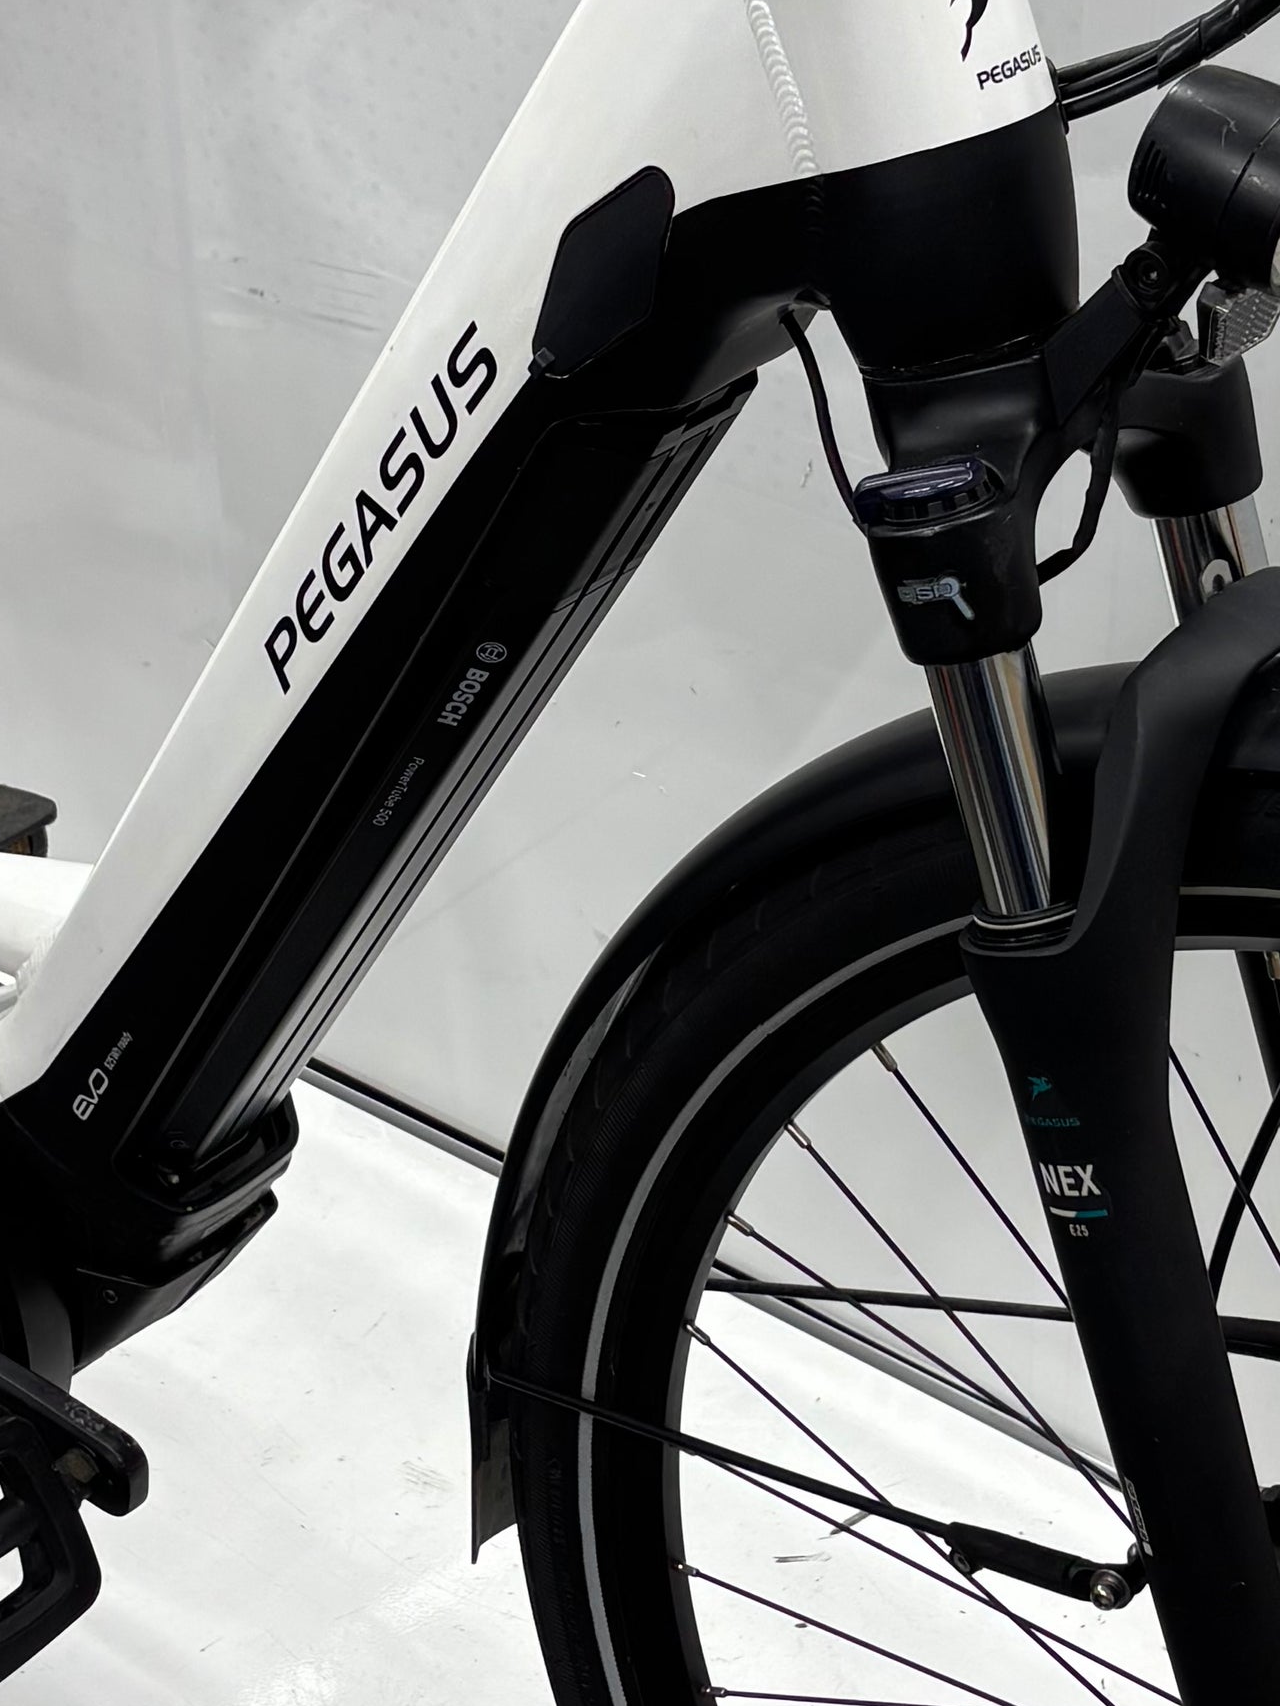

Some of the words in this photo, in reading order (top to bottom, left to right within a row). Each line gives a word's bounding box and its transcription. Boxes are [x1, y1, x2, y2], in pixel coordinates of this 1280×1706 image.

[976, 45, 1042, 91] PEGASUS
[263, 320, 500, 695] PEGASUS
[437, 667, 490, 727] BOSCH
[372, 807, 394, 827] 500
[73, 1067, 109, 1121] EVO
[1038, 1161, 1102, 1197] NEX
[1068, 1223, 1090, 1238] E25
